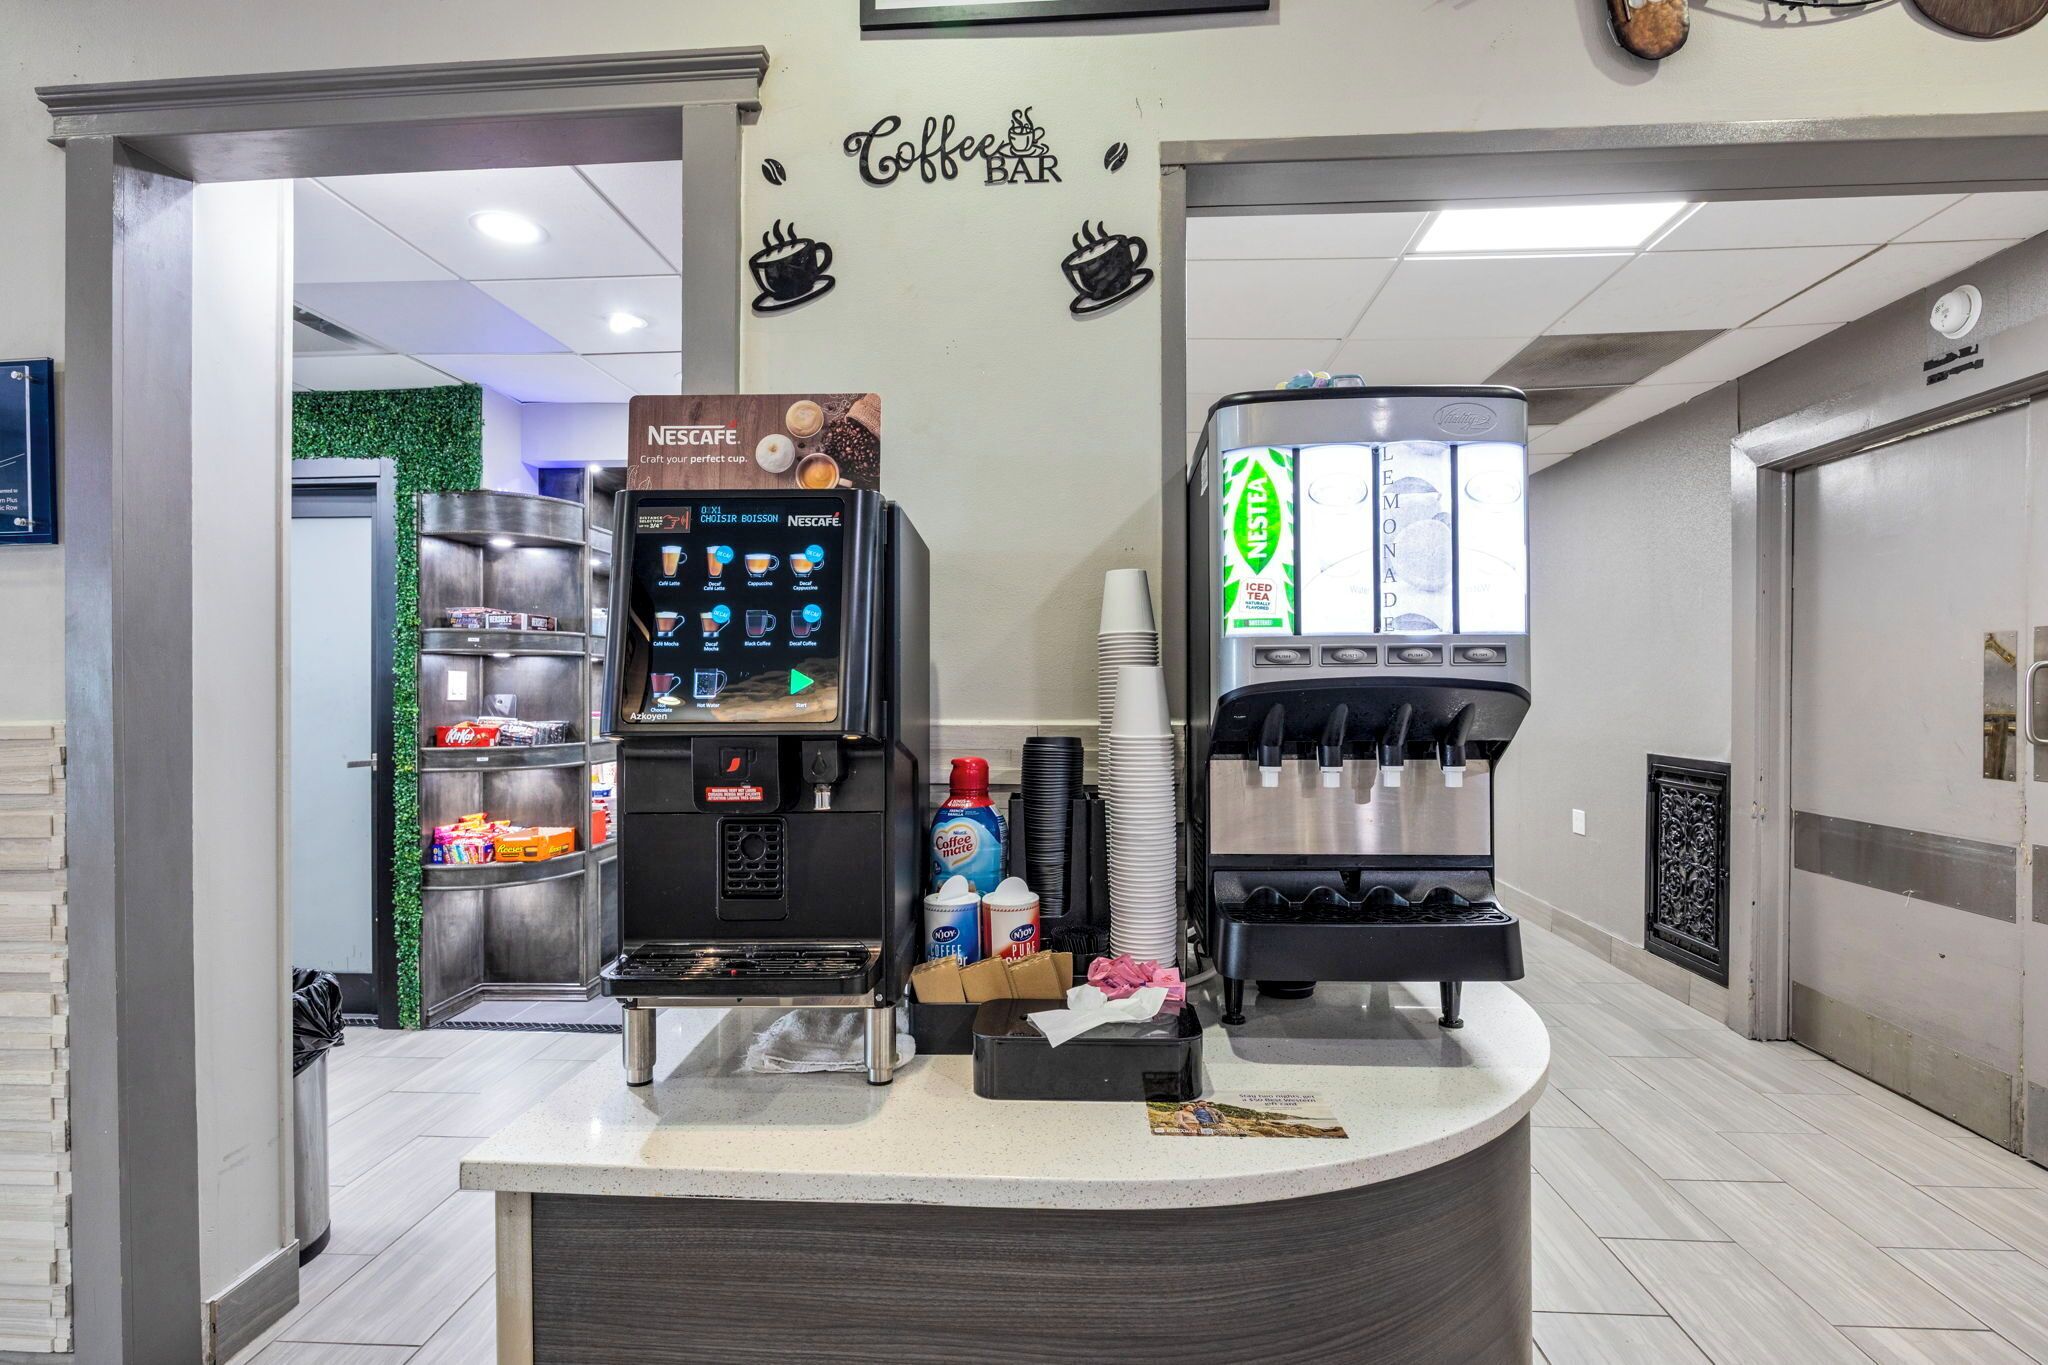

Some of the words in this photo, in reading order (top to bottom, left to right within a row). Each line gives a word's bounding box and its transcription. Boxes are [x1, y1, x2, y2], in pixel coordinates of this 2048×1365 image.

[843, 114, 1001, 186] Coffee
[985, 155, 1062, 185] BAR
[640, 455, 664, 464] Craft
[666, 456, 688, 465] your
[690, 454, 725, 465] perfect
[727, 456, 748, 464] cup.
[700, 514, 738, 523] CHOISIR
[741, 514, 779, 523] BOISSON
[1247, 476, 1268, 559] NESTEA
[1382, 446, 1400, 632] LEMONADE
[1245, 582, 1273, 592] ICED
[1247, 591, 1270, 601] TEA
[630, 712, 668, 721] Azkoyen
[935, 835, 972, 851] Coffee
[943, 843, 973, 858] mate
[930, 944, 962, 956] COFFEE
[1012, 940, 1036, 957] PURE
